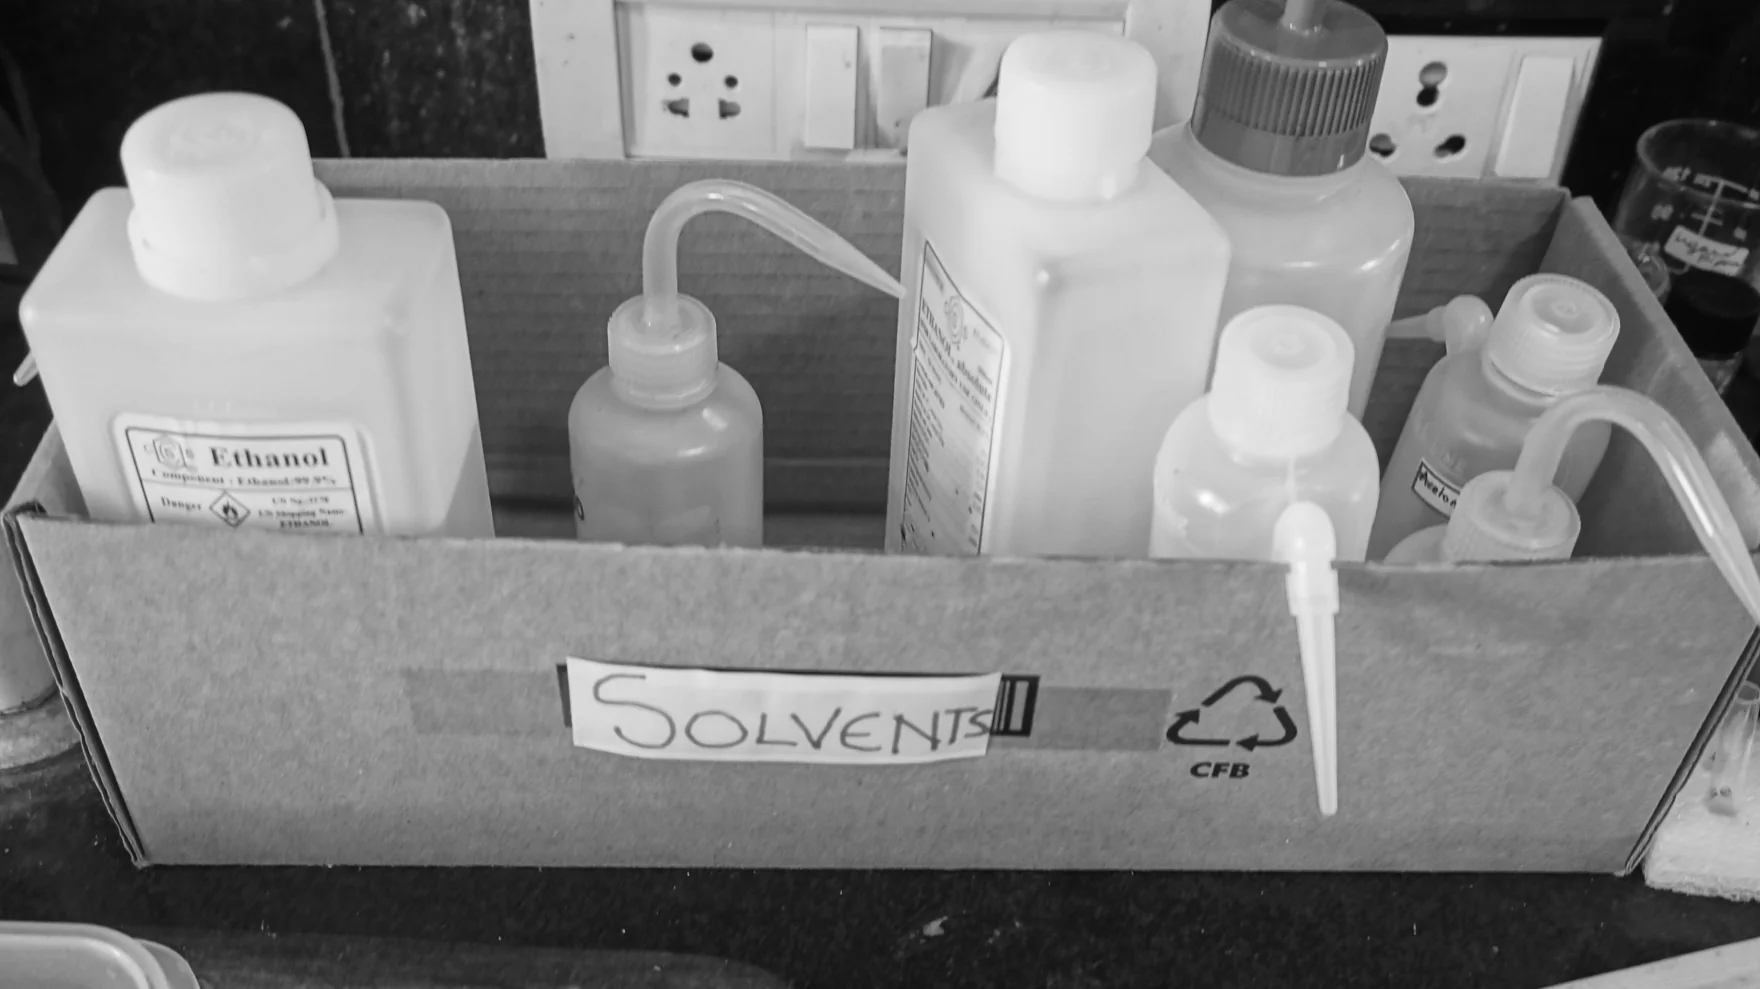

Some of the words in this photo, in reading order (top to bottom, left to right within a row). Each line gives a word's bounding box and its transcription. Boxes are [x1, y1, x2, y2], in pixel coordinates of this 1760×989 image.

[208, 445, 329, 469] Ethanol
[151, 467, 225, 485] Component
[1419, 471, 1457, 509] Aceton
[161, 495, 202, 512] Danger
[592, 674, 994, 755] SOLVENTS
[1190, 761, 1250, 779] CFB
